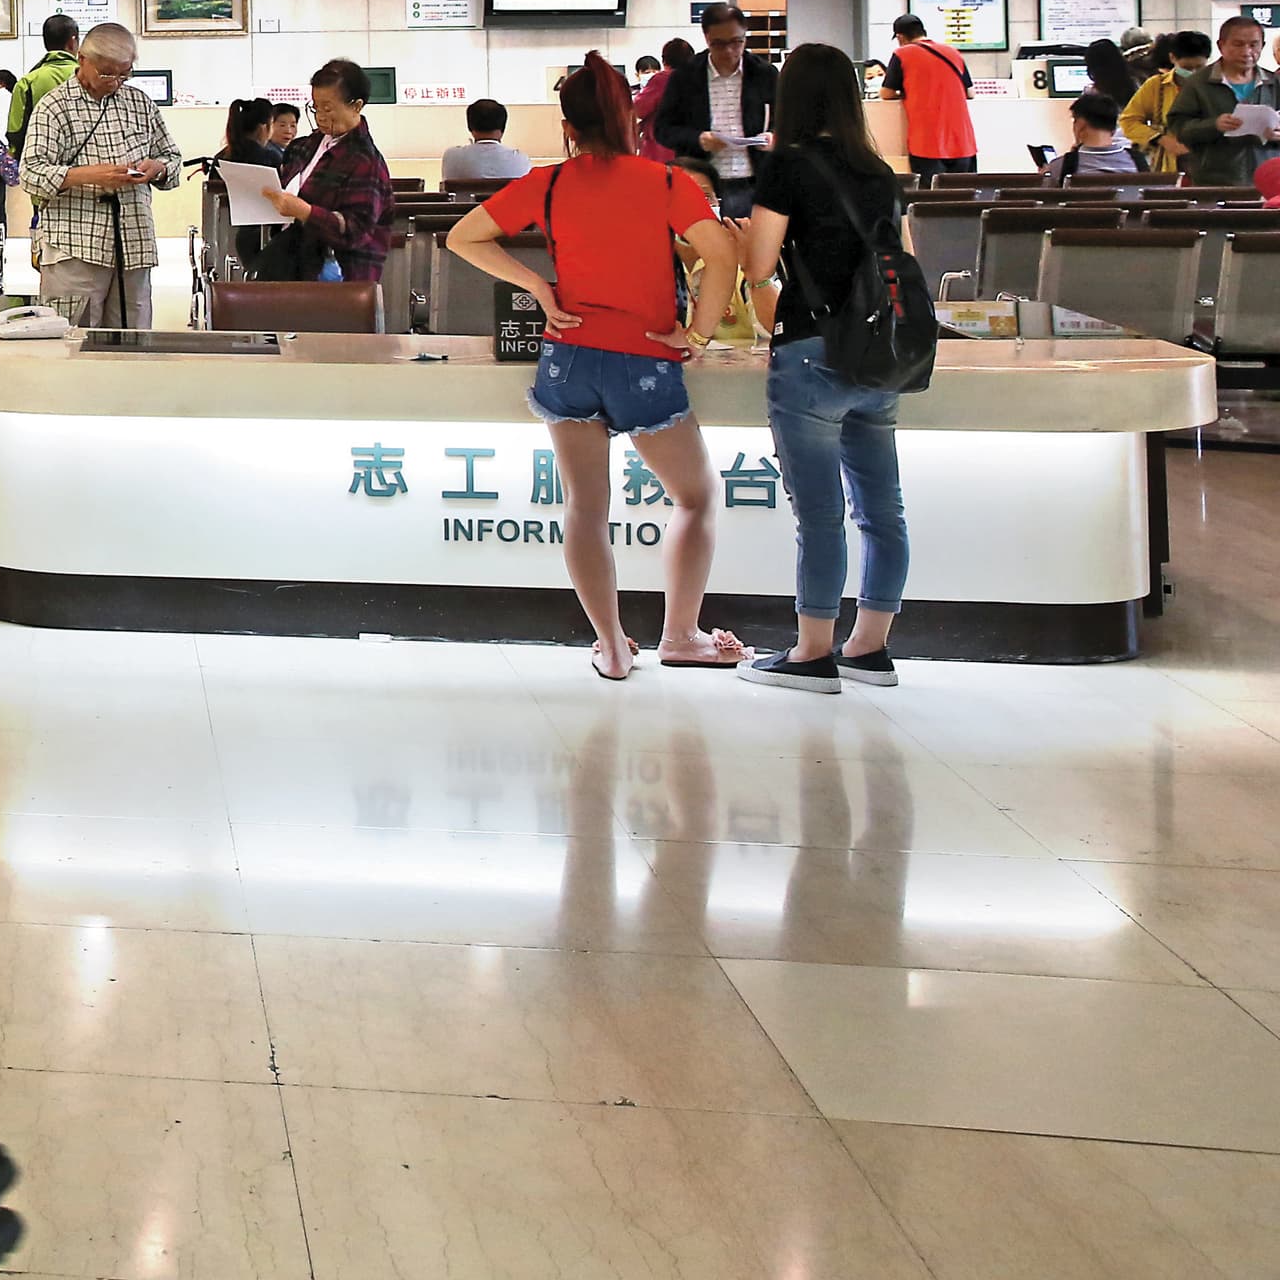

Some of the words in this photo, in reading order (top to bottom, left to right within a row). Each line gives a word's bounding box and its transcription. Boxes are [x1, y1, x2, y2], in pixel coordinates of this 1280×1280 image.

[1033, 69, 1047, 89] 8
[403, 87, 467, 99] 停止辦理
[500, 320, 543, 338] 志工
[500, 340, 543, 353] INFO
[442, 518, 668, 546] INFORMTIO
